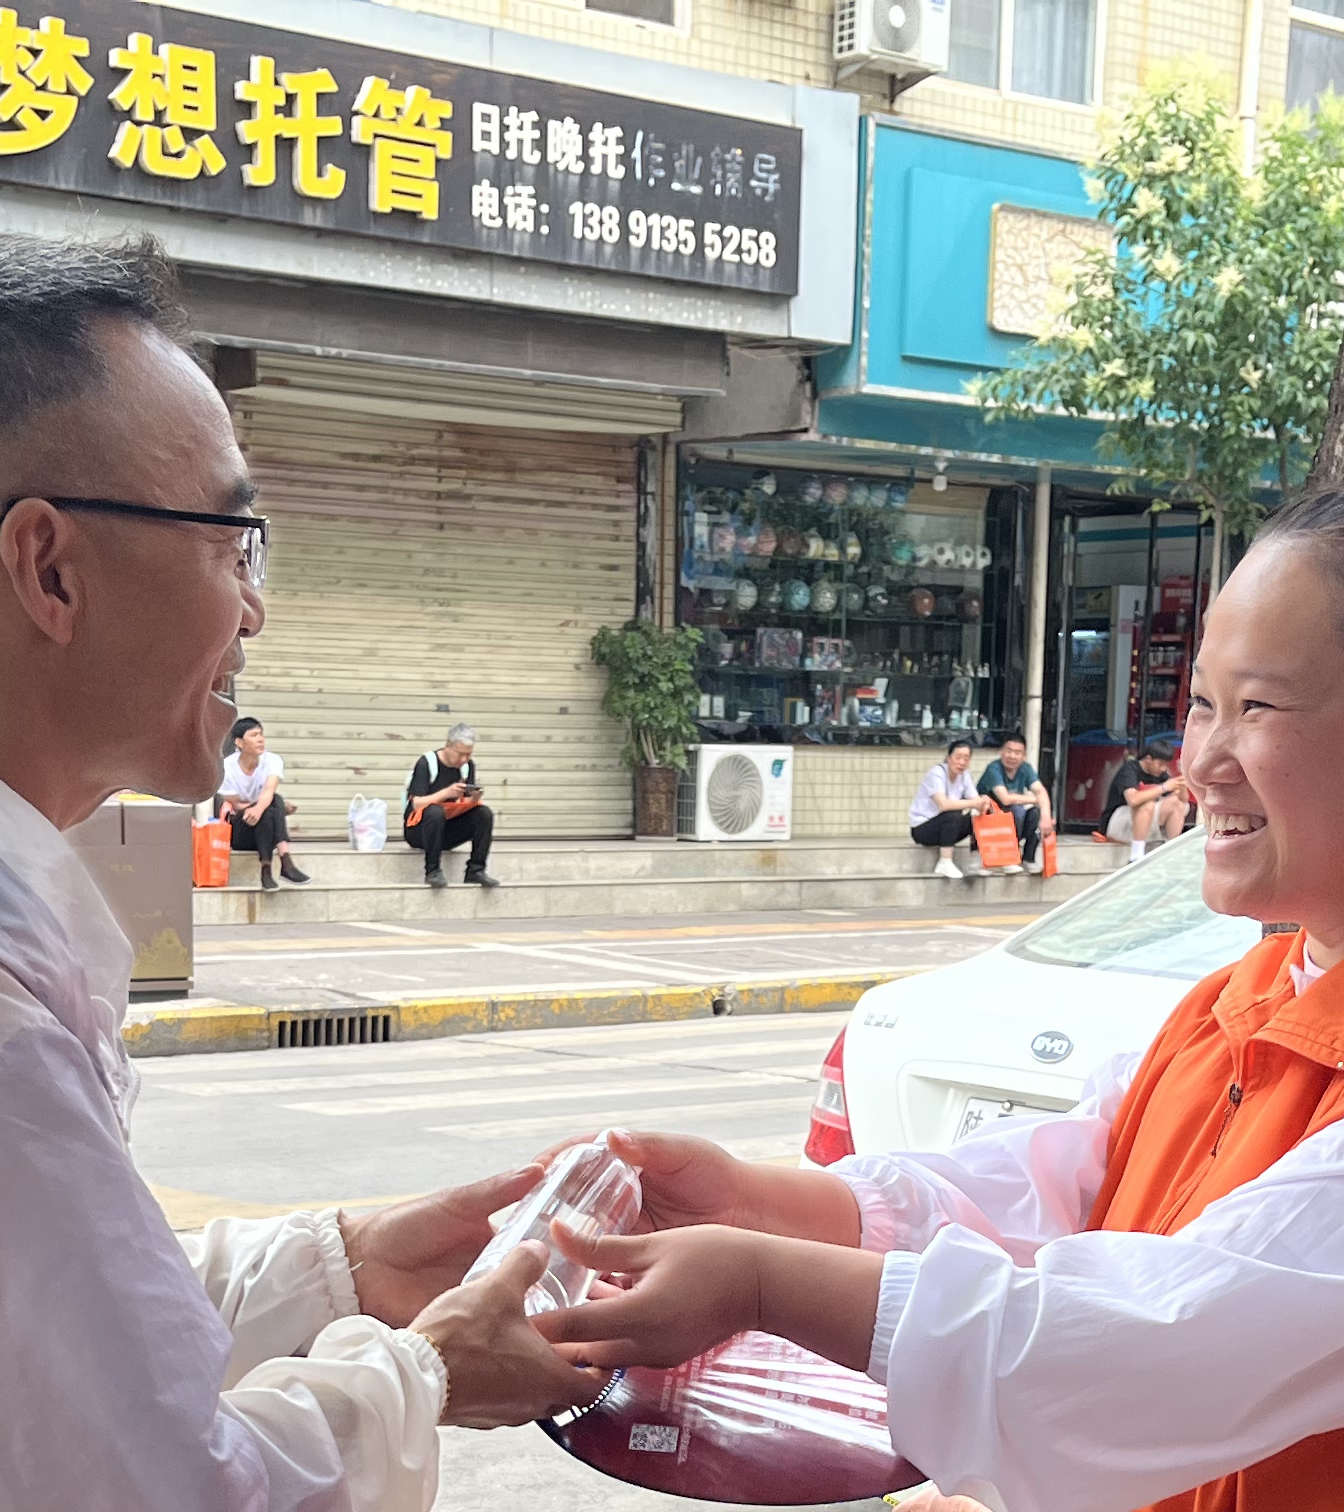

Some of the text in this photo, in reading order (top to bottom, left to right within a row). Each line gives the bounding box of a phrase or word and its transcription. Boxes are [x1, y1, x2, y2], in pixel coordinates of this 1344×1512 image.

[568, 200, 621, 245] 138
[627, 208, 697, 255] 9135
[702, 220, 778, 269] 5258
